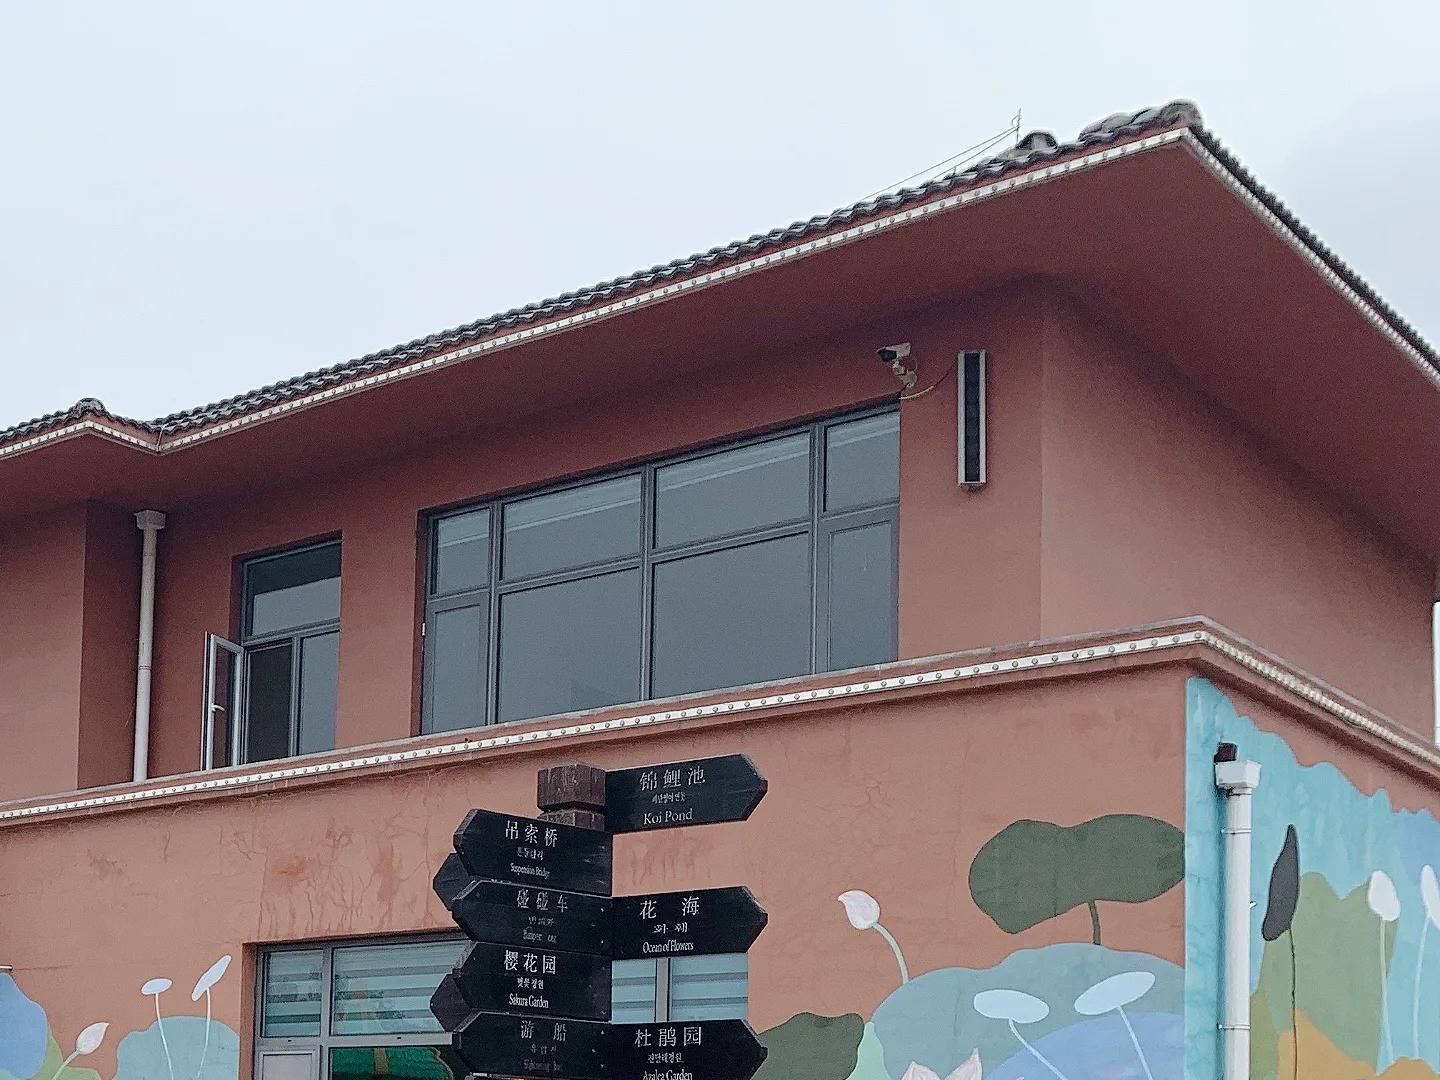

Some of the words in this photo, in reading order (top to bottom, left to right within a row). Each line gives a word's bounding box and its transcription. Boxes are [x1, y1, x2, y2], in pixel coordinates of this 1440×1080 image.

[639, 765, 706, 791] 锦鲤池
[643, 811, 662, 825] Koi
[665, 807, 693, 823] Pond
[505, 820, 558, 848] 吊索桥
[517, 889, 569, 913] 碰碰车
[639, 896, 700, 920] 花海
[642, 941, 662, 954] Ocean
[670, 939, 694, 952] Flowers
[503, 949, 557, 975] 樱花园
[509, 992, 528, 1007] Sakura
[528, 994, 549, 1009] Garden
[520, 1020, 568, 1042] 游船
[634, 1026, 702, 1048] 杜鹃园
